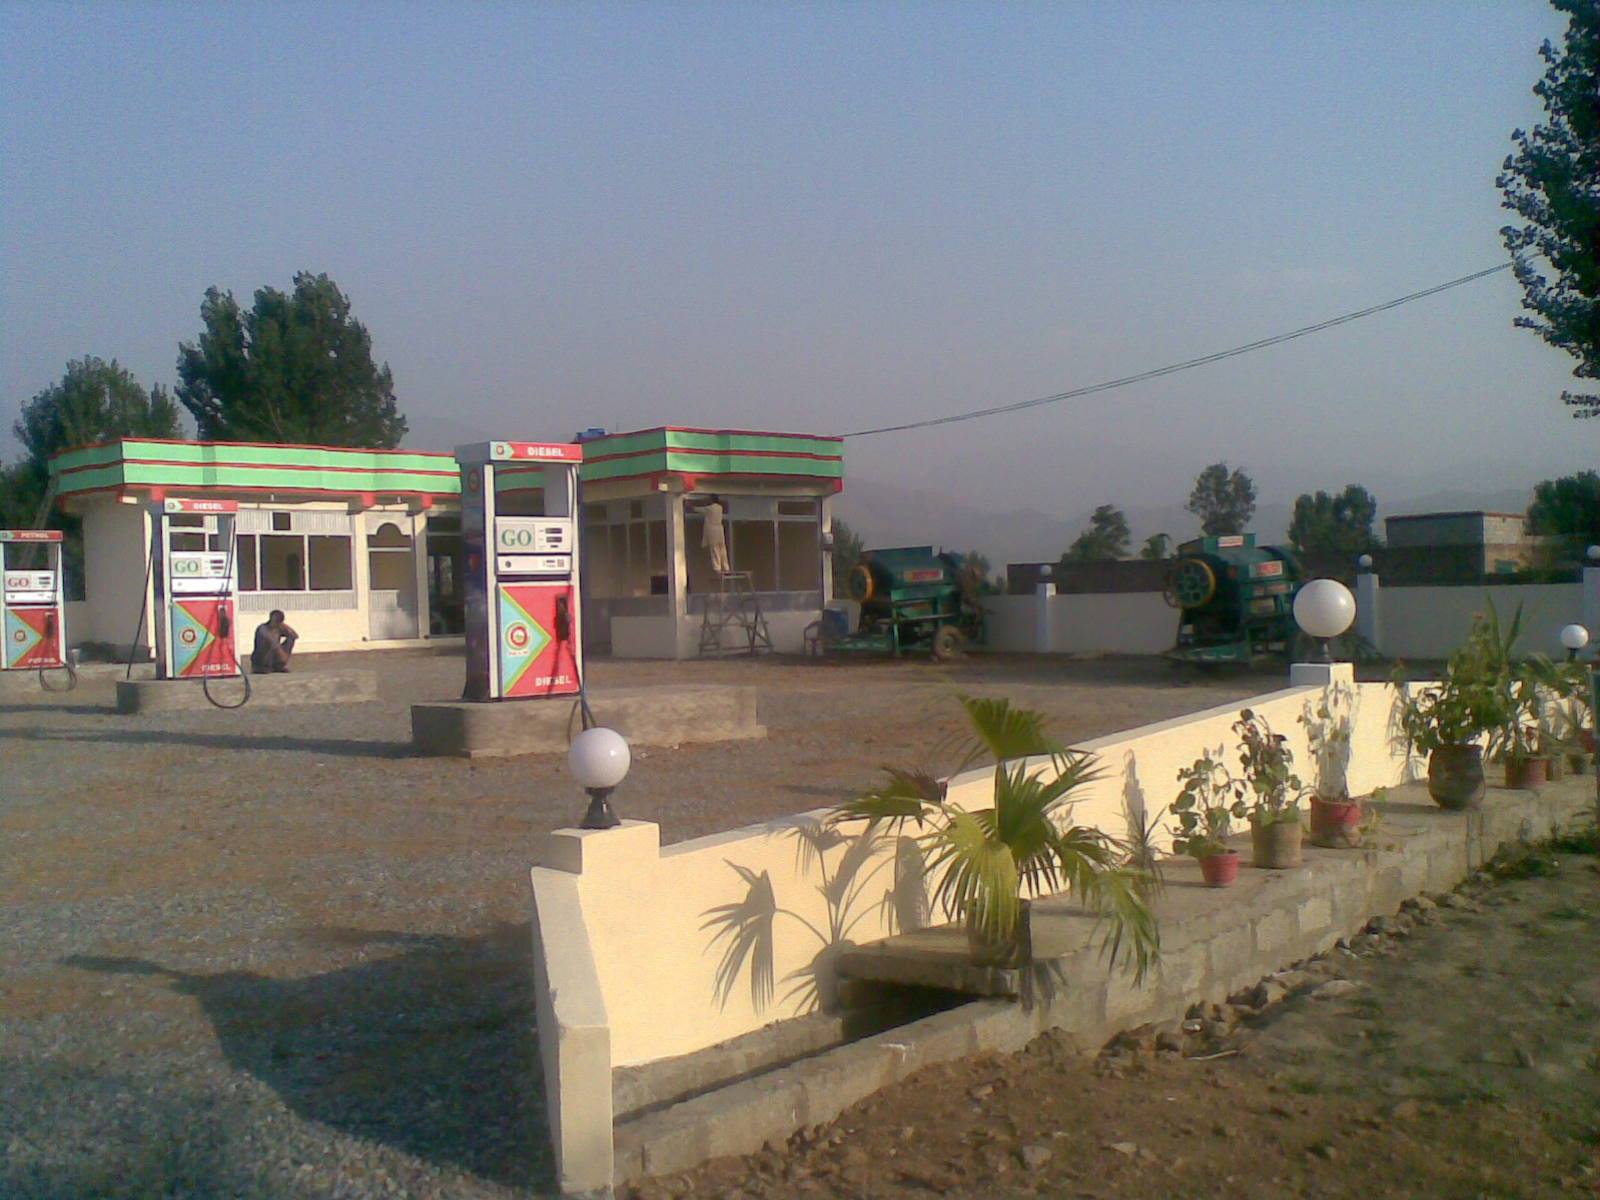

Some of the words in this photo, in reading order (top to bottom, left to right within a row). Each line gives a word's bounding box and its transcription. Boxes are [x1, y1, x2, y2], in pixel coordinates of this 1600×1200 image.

[527, 446, 564, 457] DIESEL
[502, 529, 532, 547] GO
[174, 560, 199, 573] GO
[8, 577, 30, 587] GO
